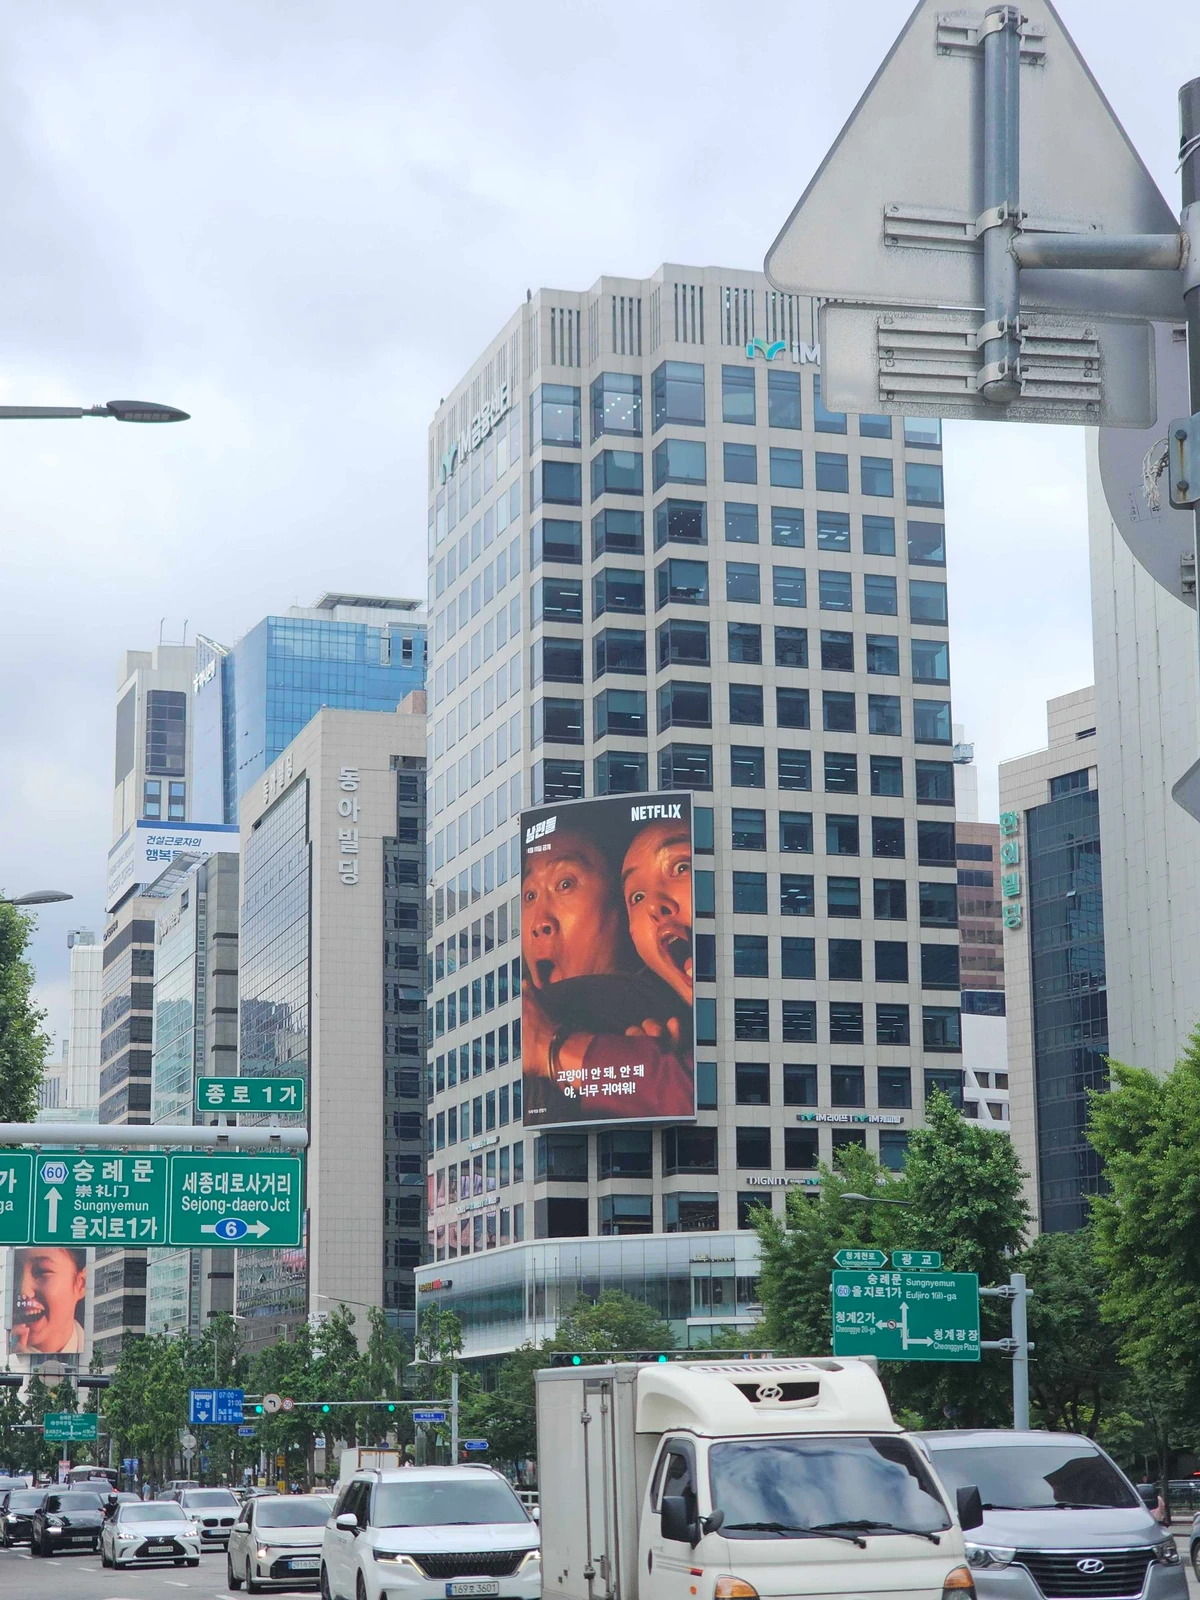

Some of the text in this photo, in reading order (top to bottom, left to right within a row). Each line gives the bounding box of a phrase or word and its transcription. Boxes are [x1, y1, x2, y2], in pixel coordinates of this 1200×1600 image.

[631, 804, 682, 822] NETFLIX
[338, 767, 360, 885] 동아빌딩
[146, 835, 202, 847] 건설근로자의
[557, 1064, 645, 1083] 고양이! 안 돼, 안 돼
[564, 1082, 636, 1099] 야, 너무 귀여워!
[47, 1167, 63, 1179] 60
[73, 1159, 154, 1182] 숭례문
[182, 1172, 291, 1195] 세종대로사거리
[749, 1176, 790, 1186] DIGNITY
[74, 1200, 149, 1213] Sungnyemun
[182, 1196, 290, 1215] Sejong-daero Jct
[70, 1216, 157, 1239] 을지로1가
[225, 1221, 237, 1236] 6
[845, 1251, 876, 1260] 청계천로
[901, 1253, 932, 1265] 광교
[867, 1273, 902, 1285] 숭례문
[906, 1278, 955, 1288] Sungnyemun
[838, 1287, 847, 1295] 60
[852, 1286, 902, 1298] 을지로1가
[906, 1291, 930, 1300] Euljiro
[836, 1311, 876, 1324] 청계2가
[934, 1329, 979, 1341] 청계광장
[934, 1342, 979, 1352] Cheonggye Plaza
[476, 1584, 496, 1593] 3601
